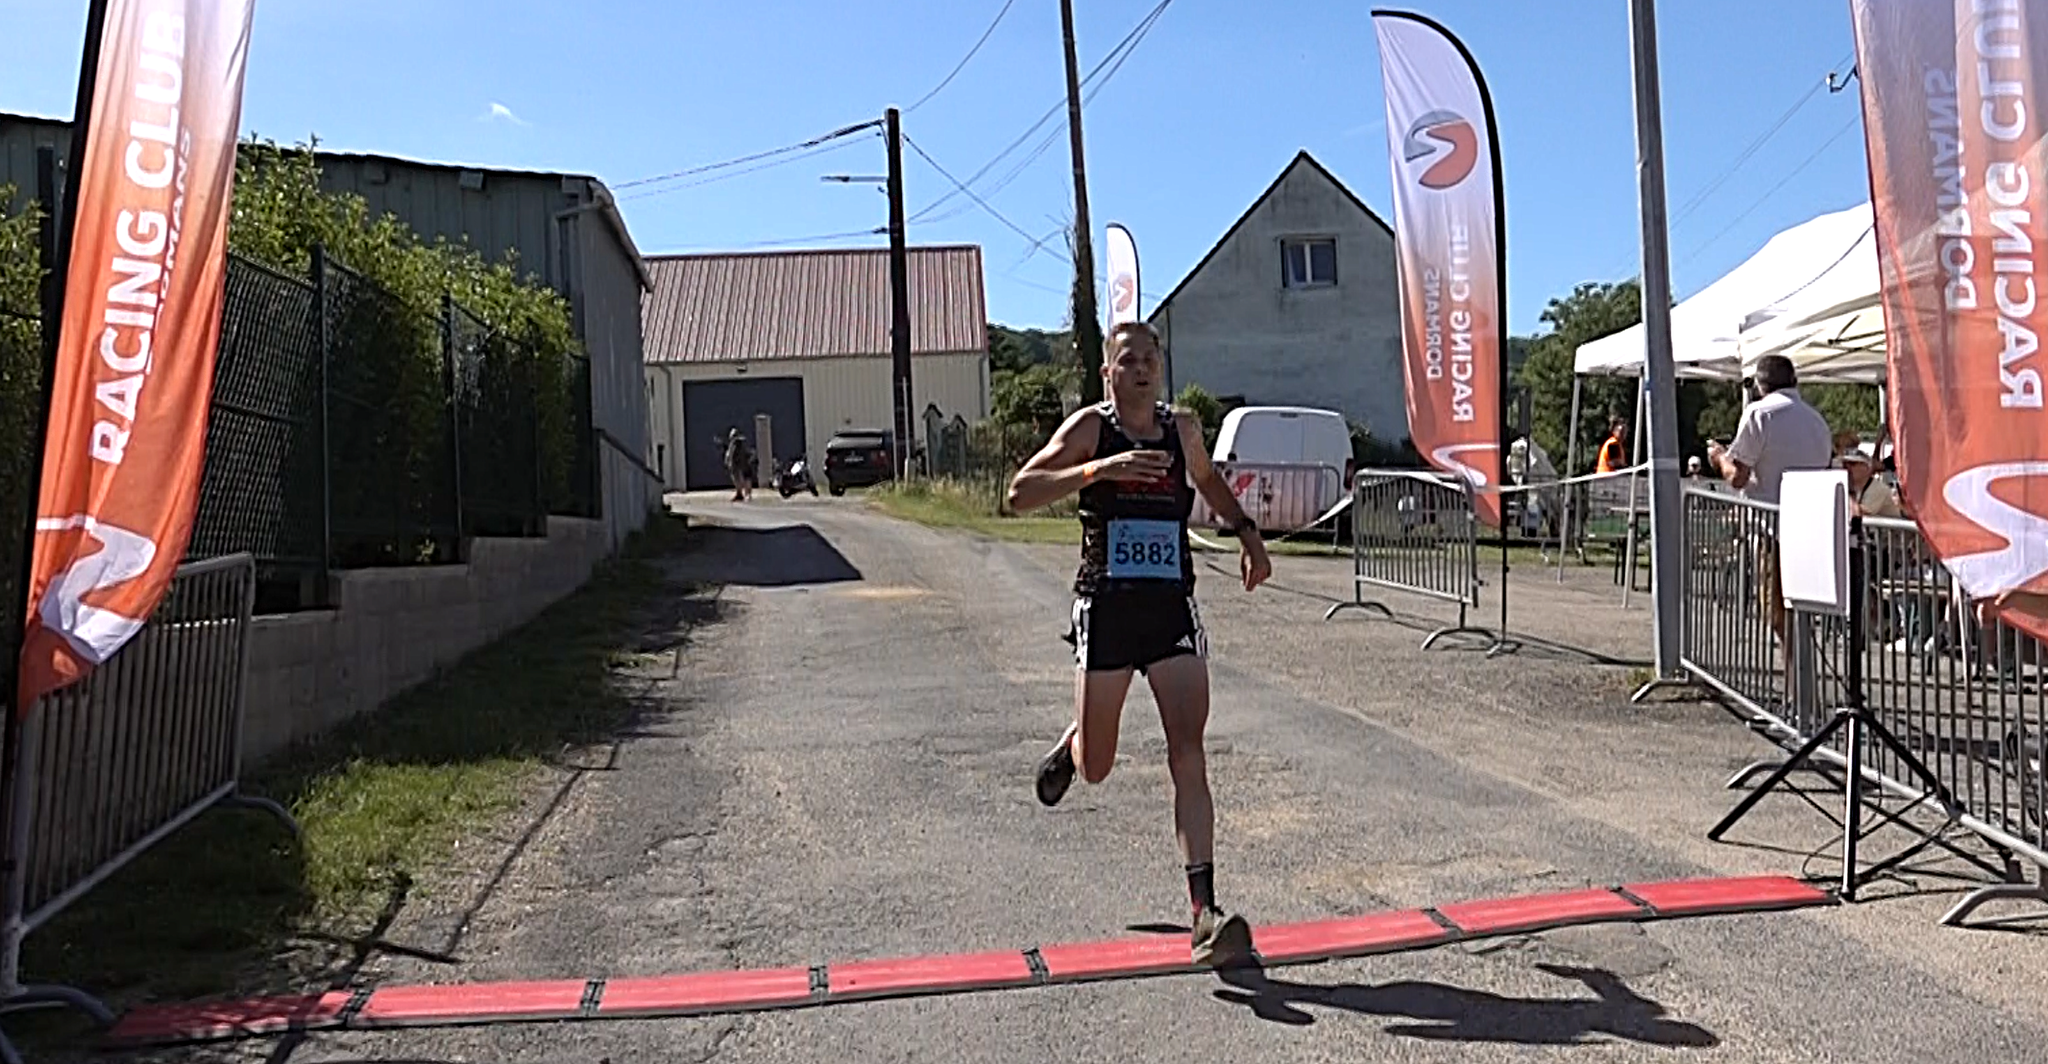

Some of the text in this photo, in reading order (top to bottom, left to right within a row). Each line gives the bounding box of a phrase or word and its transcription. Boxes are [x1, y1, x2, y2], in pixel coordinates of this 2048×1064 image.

[88, 9, 186, 466] RACING CLUB
[1114, 542, 1176, 565] 5882
